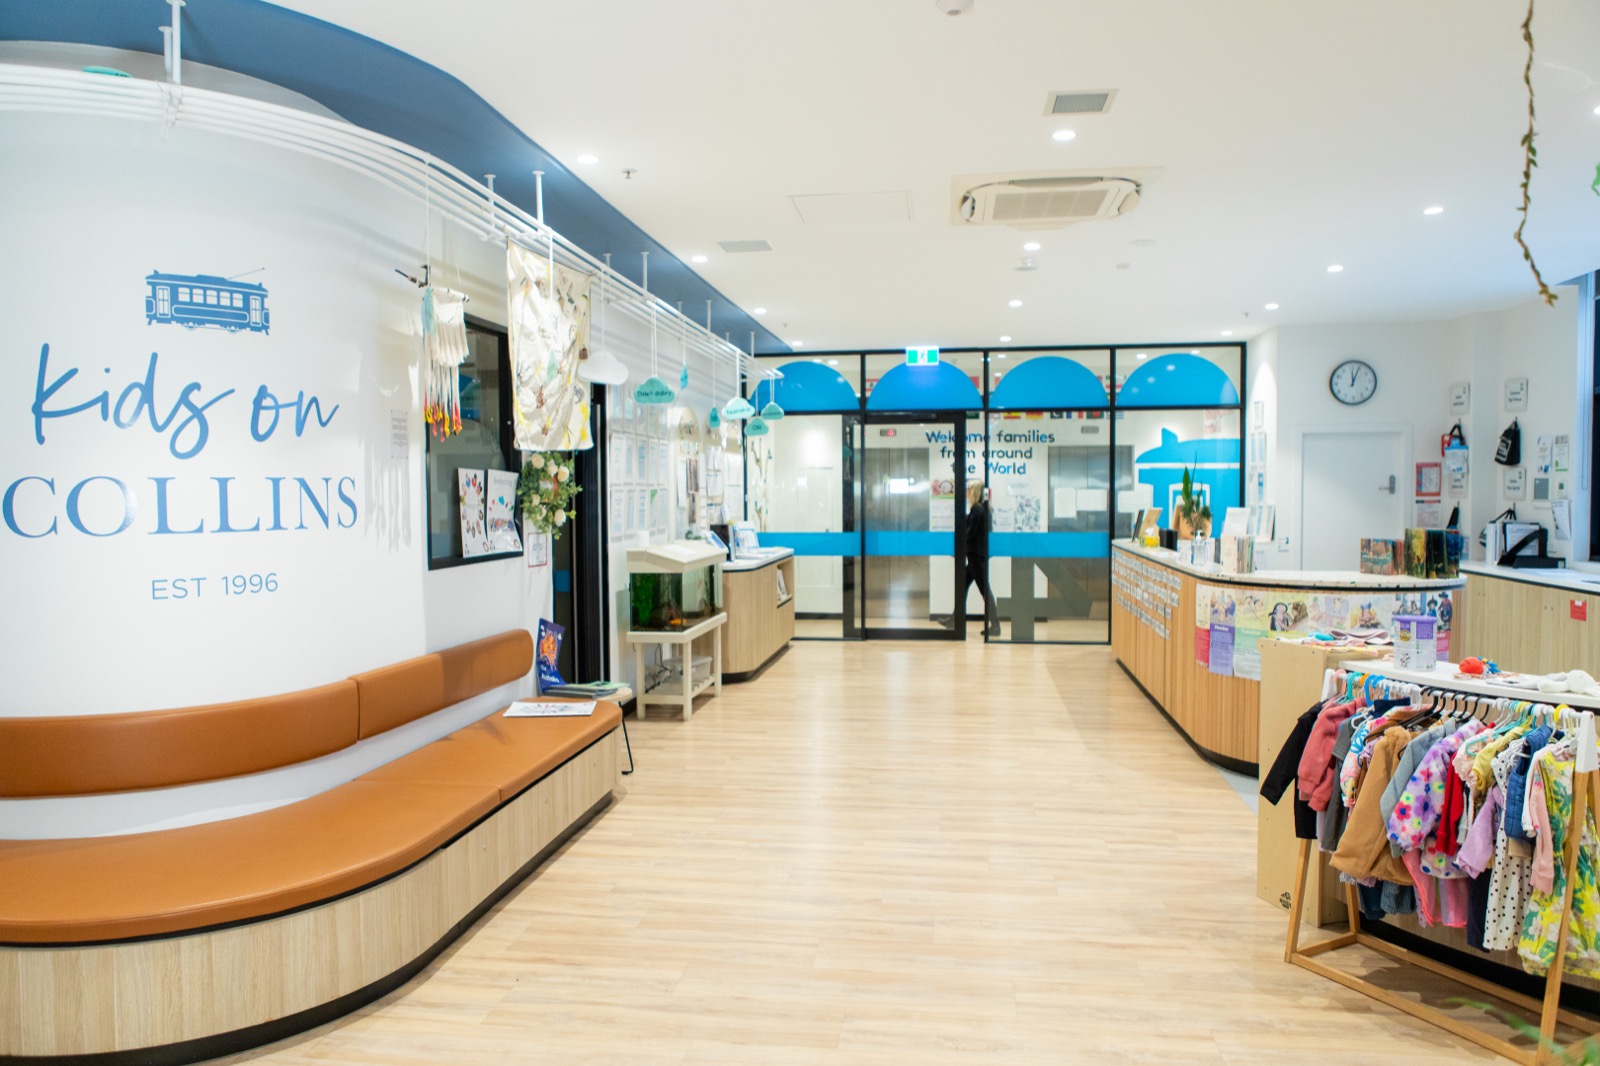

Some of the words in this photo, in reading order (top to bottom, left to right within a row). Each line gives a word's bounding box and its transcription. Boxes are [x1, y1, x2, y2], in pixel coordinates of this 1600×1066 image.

[250, 384, 340, 442] on
[997, 429, 1055, 443] families
[940, 446, 976, 459] frm
[2, 475, 359, 539] COLLINS
[152, 577, 207, 601] EST
[221, 573, 279, 596] 1996
